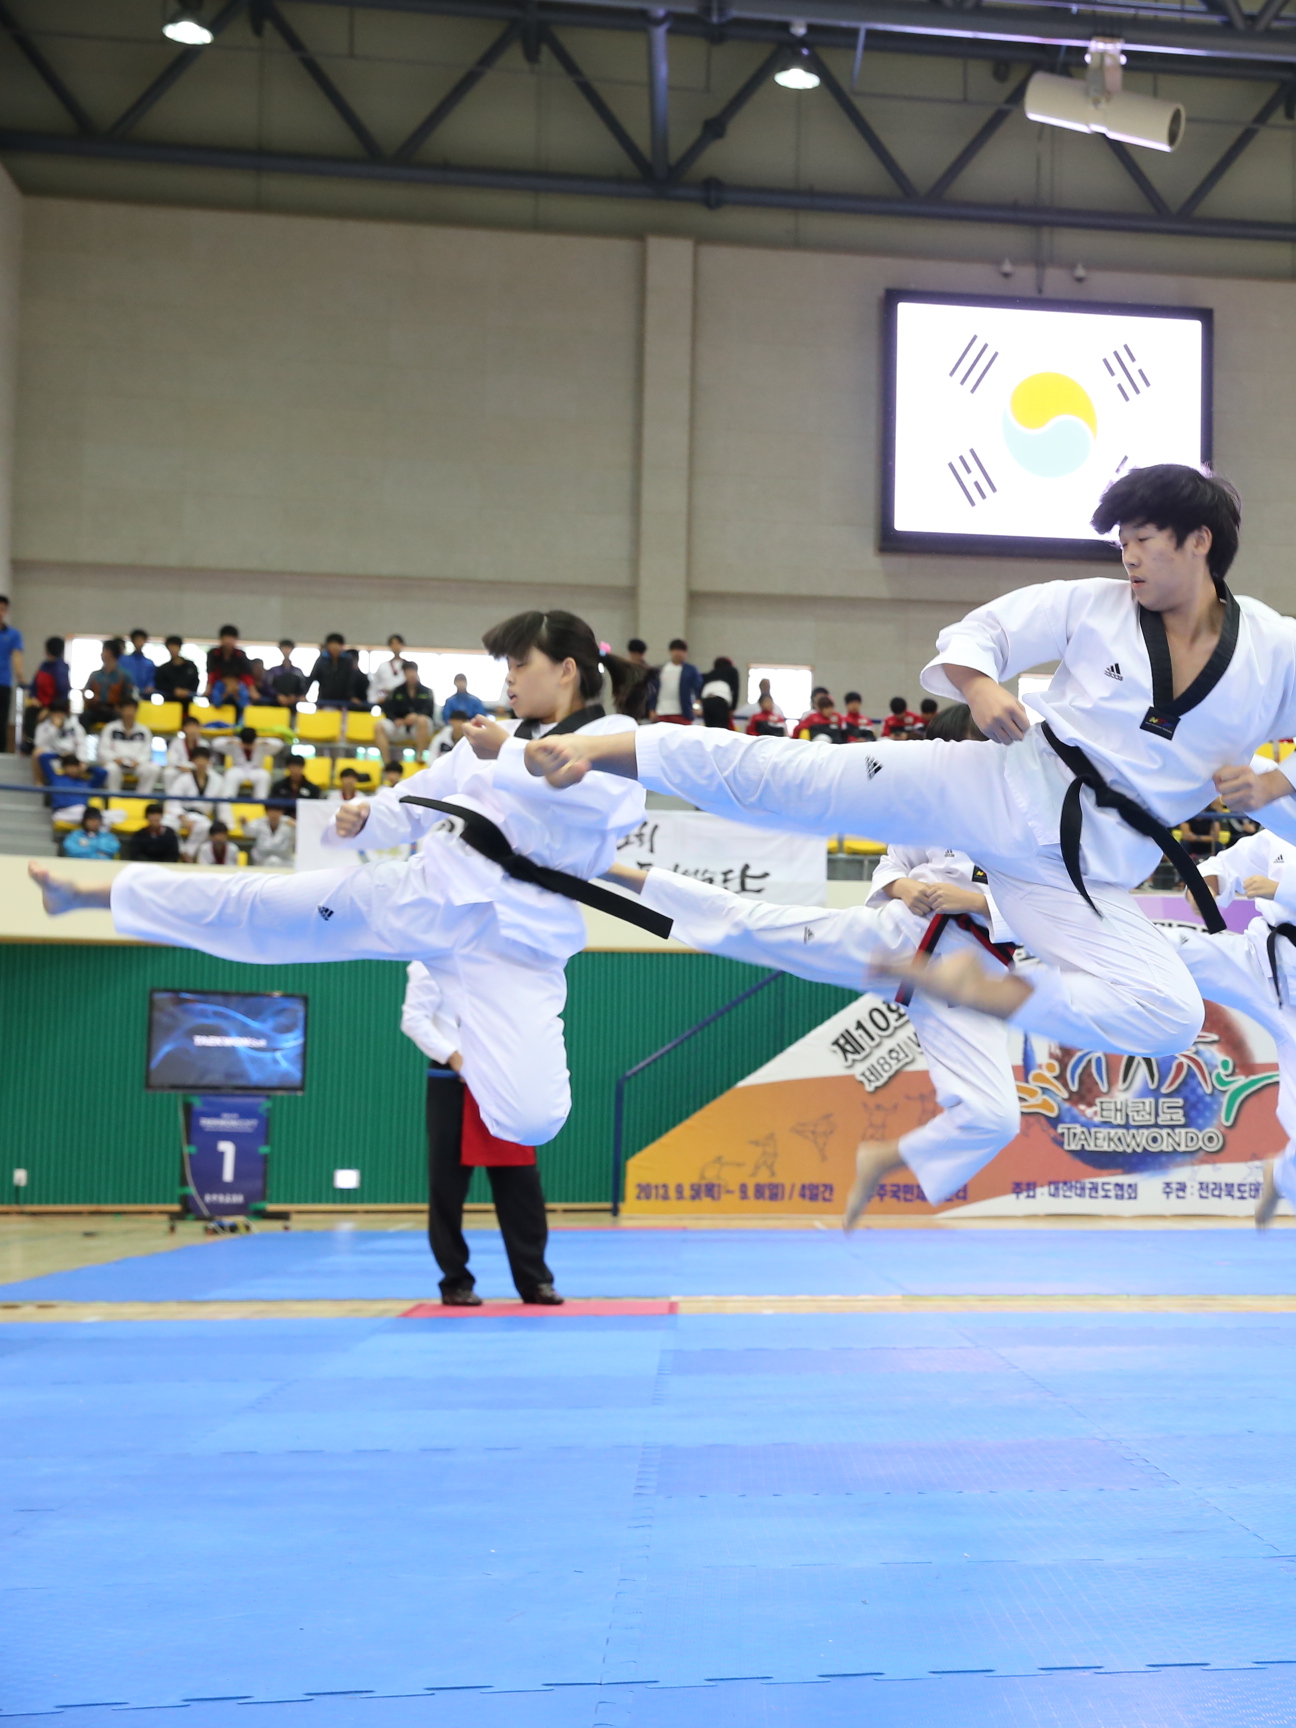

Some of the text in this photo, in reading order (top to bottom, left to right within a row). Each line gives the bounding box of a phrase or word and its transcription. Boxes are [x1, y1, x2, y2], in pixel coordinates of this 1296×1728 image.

[1098, 1099, 1185, 1123] 태권도
[1060, 1126, 1222, 1151] TAEKWONDO
[217, 1140, 236, 1183] 1
[1048, 1181, 1138, 1200] 대한태권도협회
